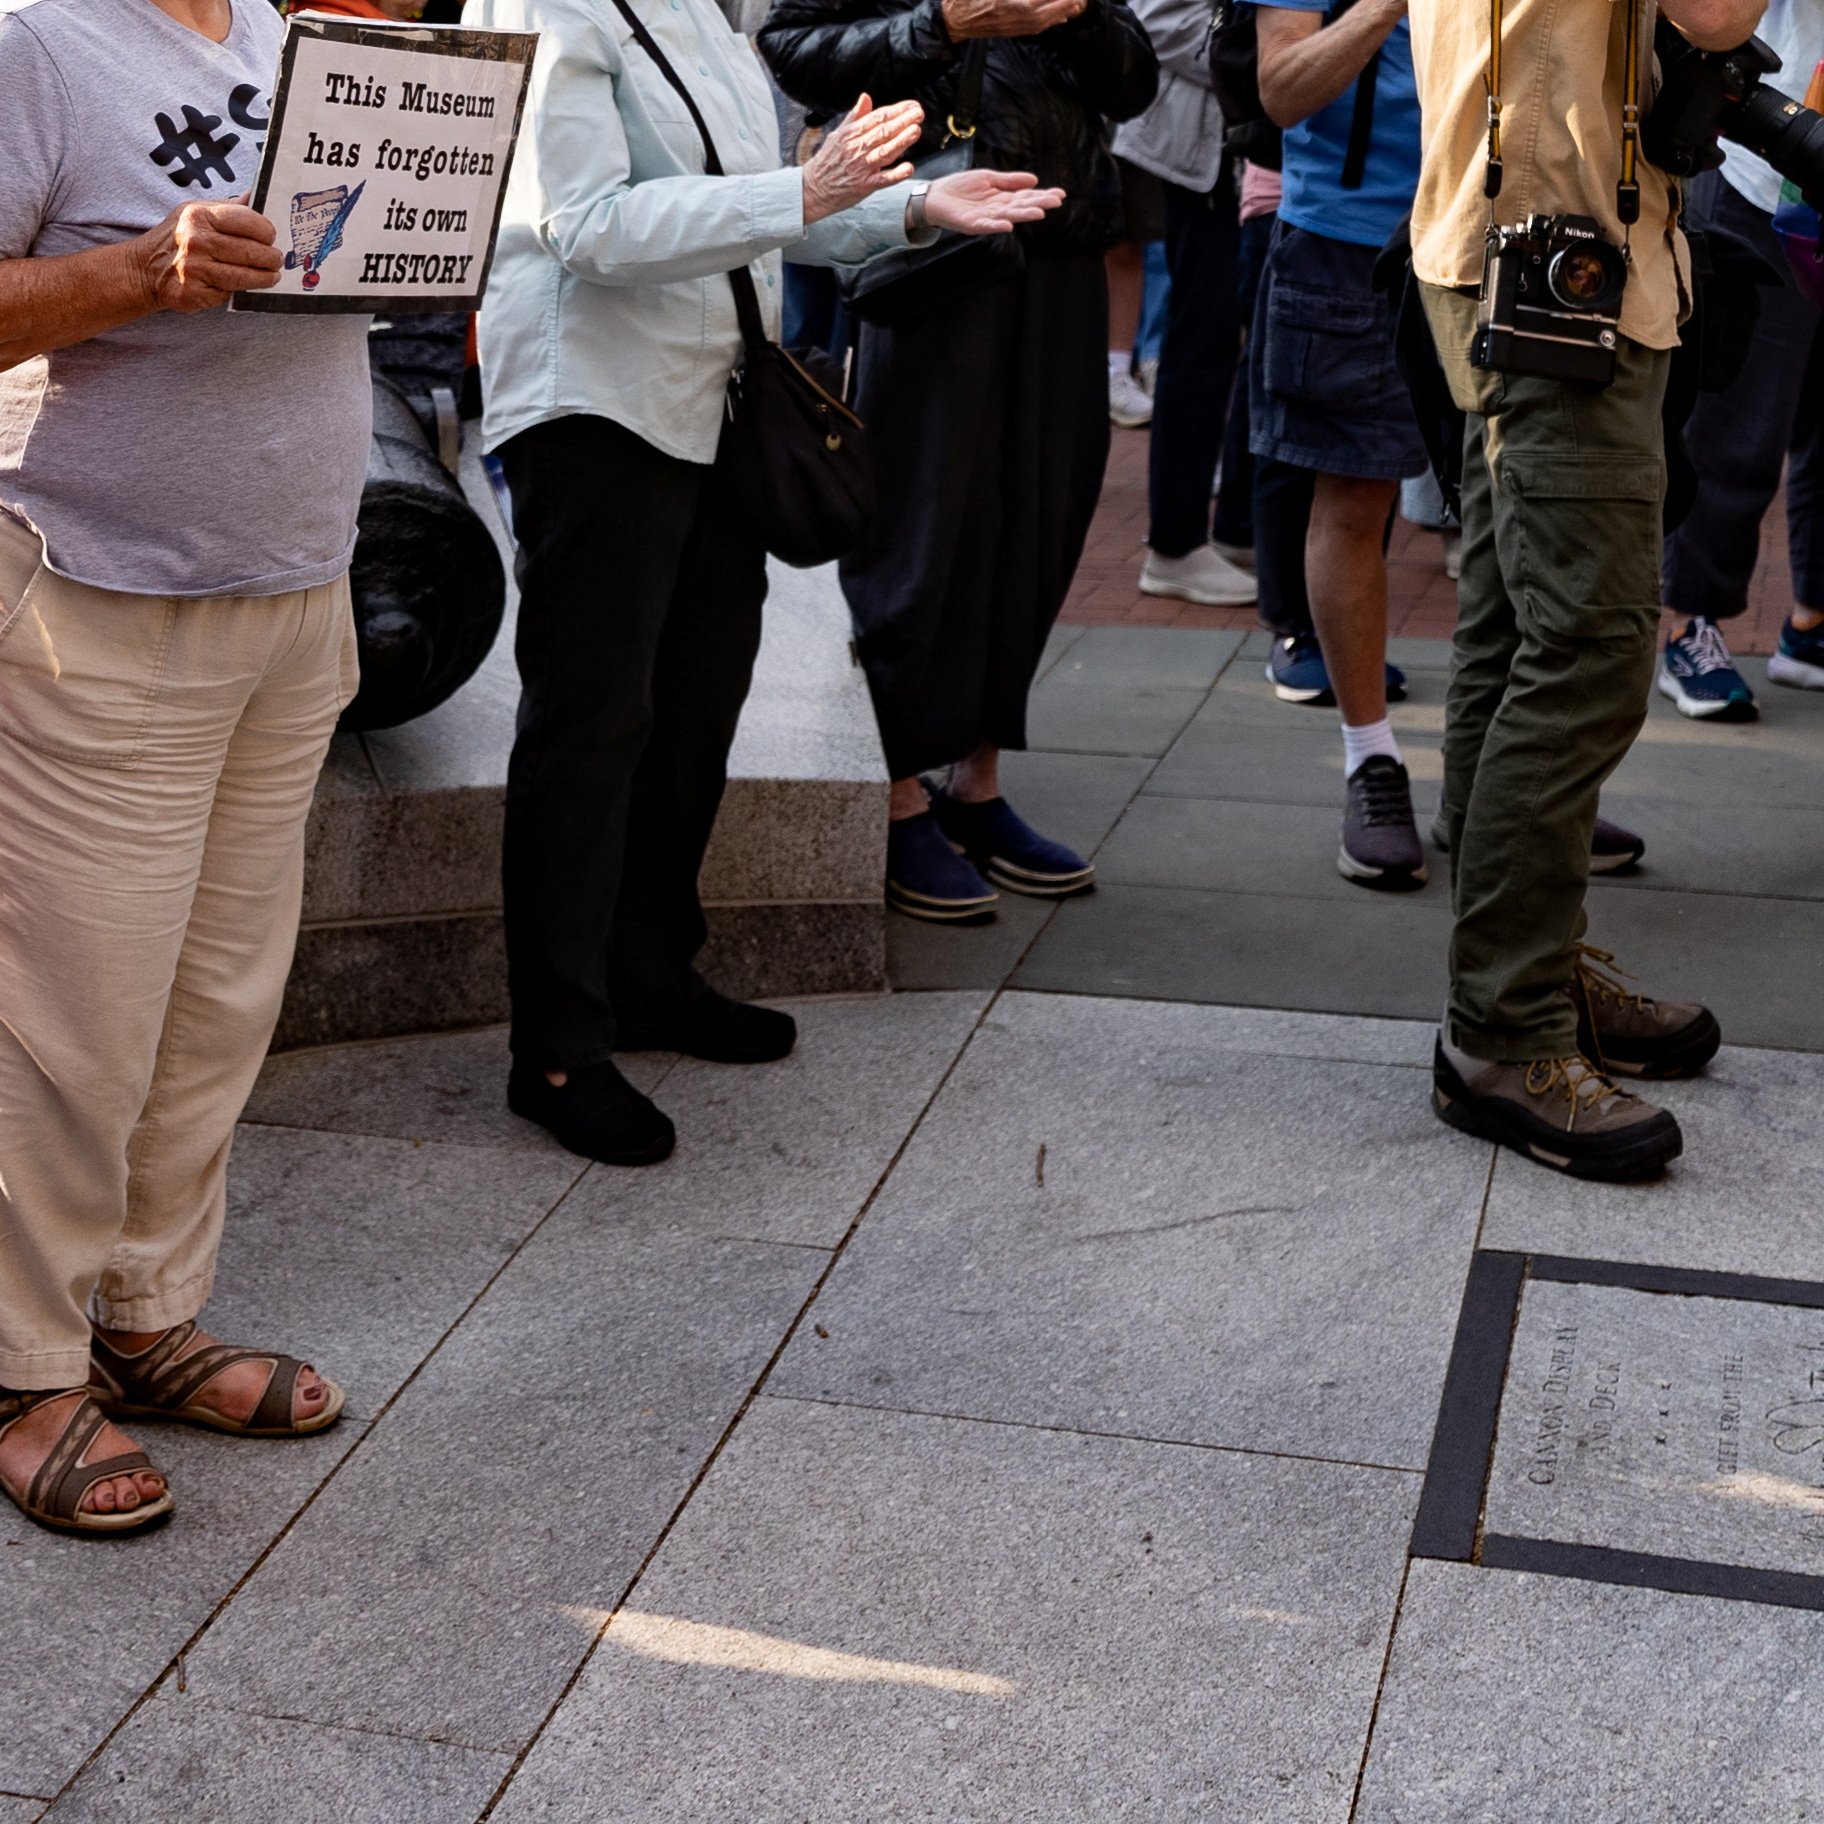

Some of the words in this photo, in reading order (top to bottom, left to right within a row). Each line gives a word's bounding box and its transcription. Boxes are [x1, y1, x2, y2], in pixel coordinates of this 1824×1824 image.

[325, 72, 387, 109] This
[398, 81, 496, 119] Museum
[302, 131, 362, 169] has
[374, 138, 495, 182] forgotten
[383, 198, 417, 234] its
[421, 206, 469, 234] own
[1564, 227, 1595, 239] Nikon
[357, 252, 474, 285] HISTORY
[1541, 1323, 1580, 1397] DISPLAY
[1719, 1350, 1746, 1383] THE
[1587, 1359, 1622, 1413] DECK
[1716, 1386, 1743, 1433] FROM
[1526, 1403, 1568, 1488] CANNON
[1716, 1437, 1742, 1478] GIFT
